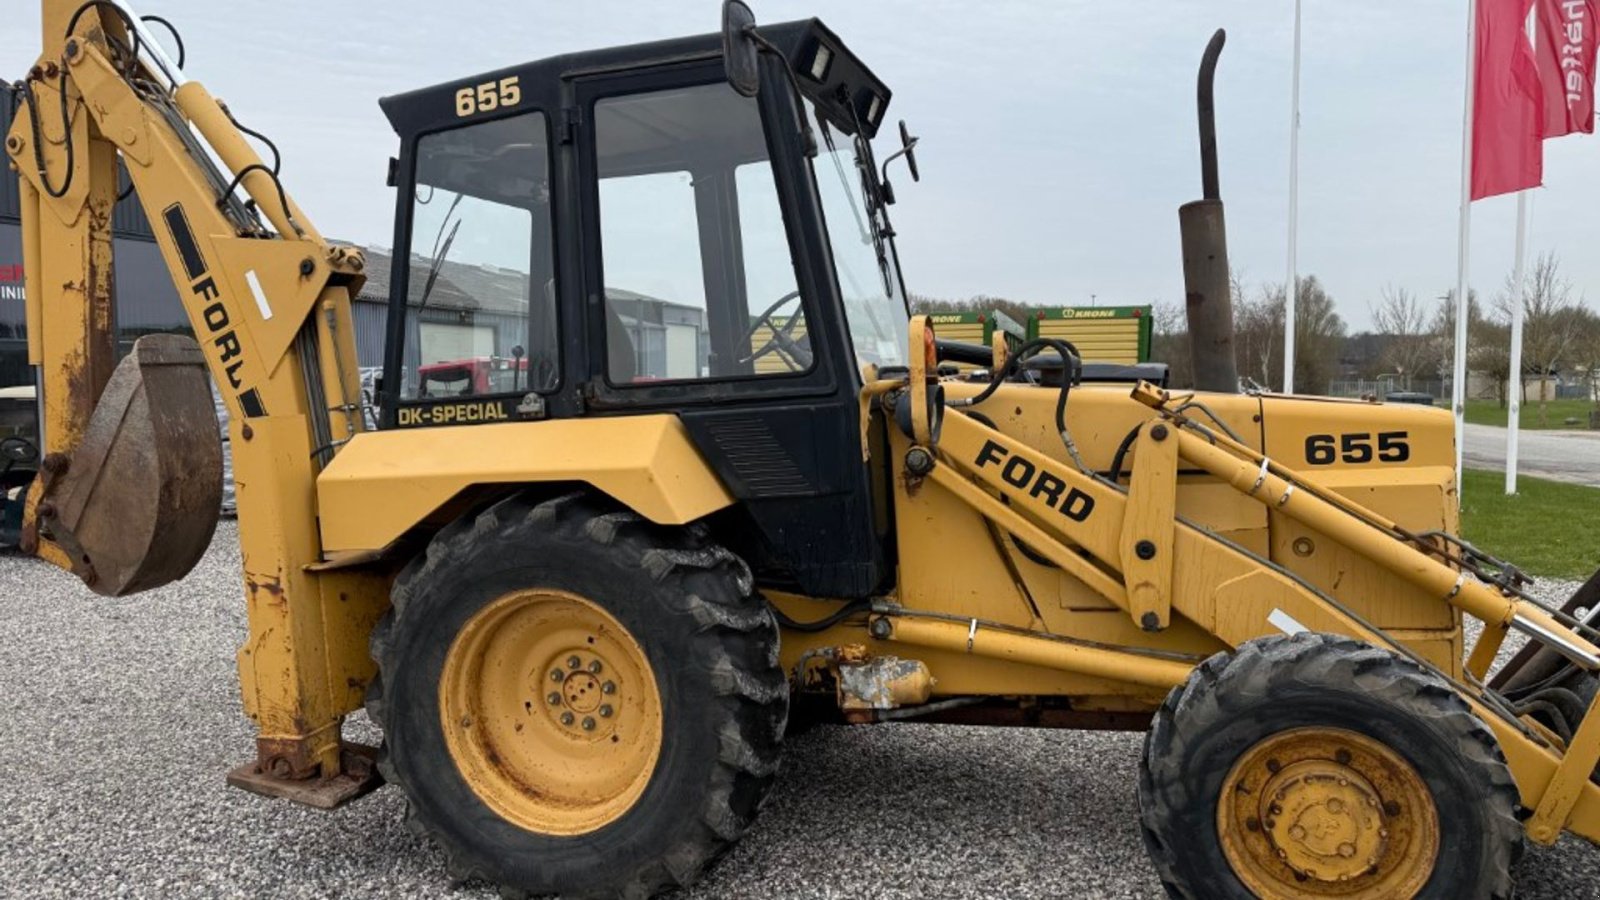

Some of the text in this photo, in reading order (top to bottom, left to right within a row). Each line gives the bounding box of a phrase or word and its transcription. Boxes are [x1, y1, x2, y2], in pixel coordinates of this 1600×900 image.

[456, 76, 521, 117] 655
[931, 315, 962, 323] RONE
[1074, 309, 1116, 318] KRONE
[398, 402, 508, 425] DK-SPECIAL
[1305, 431, 1410, 466] 655
[974, 439, 1096, 523] FORD
